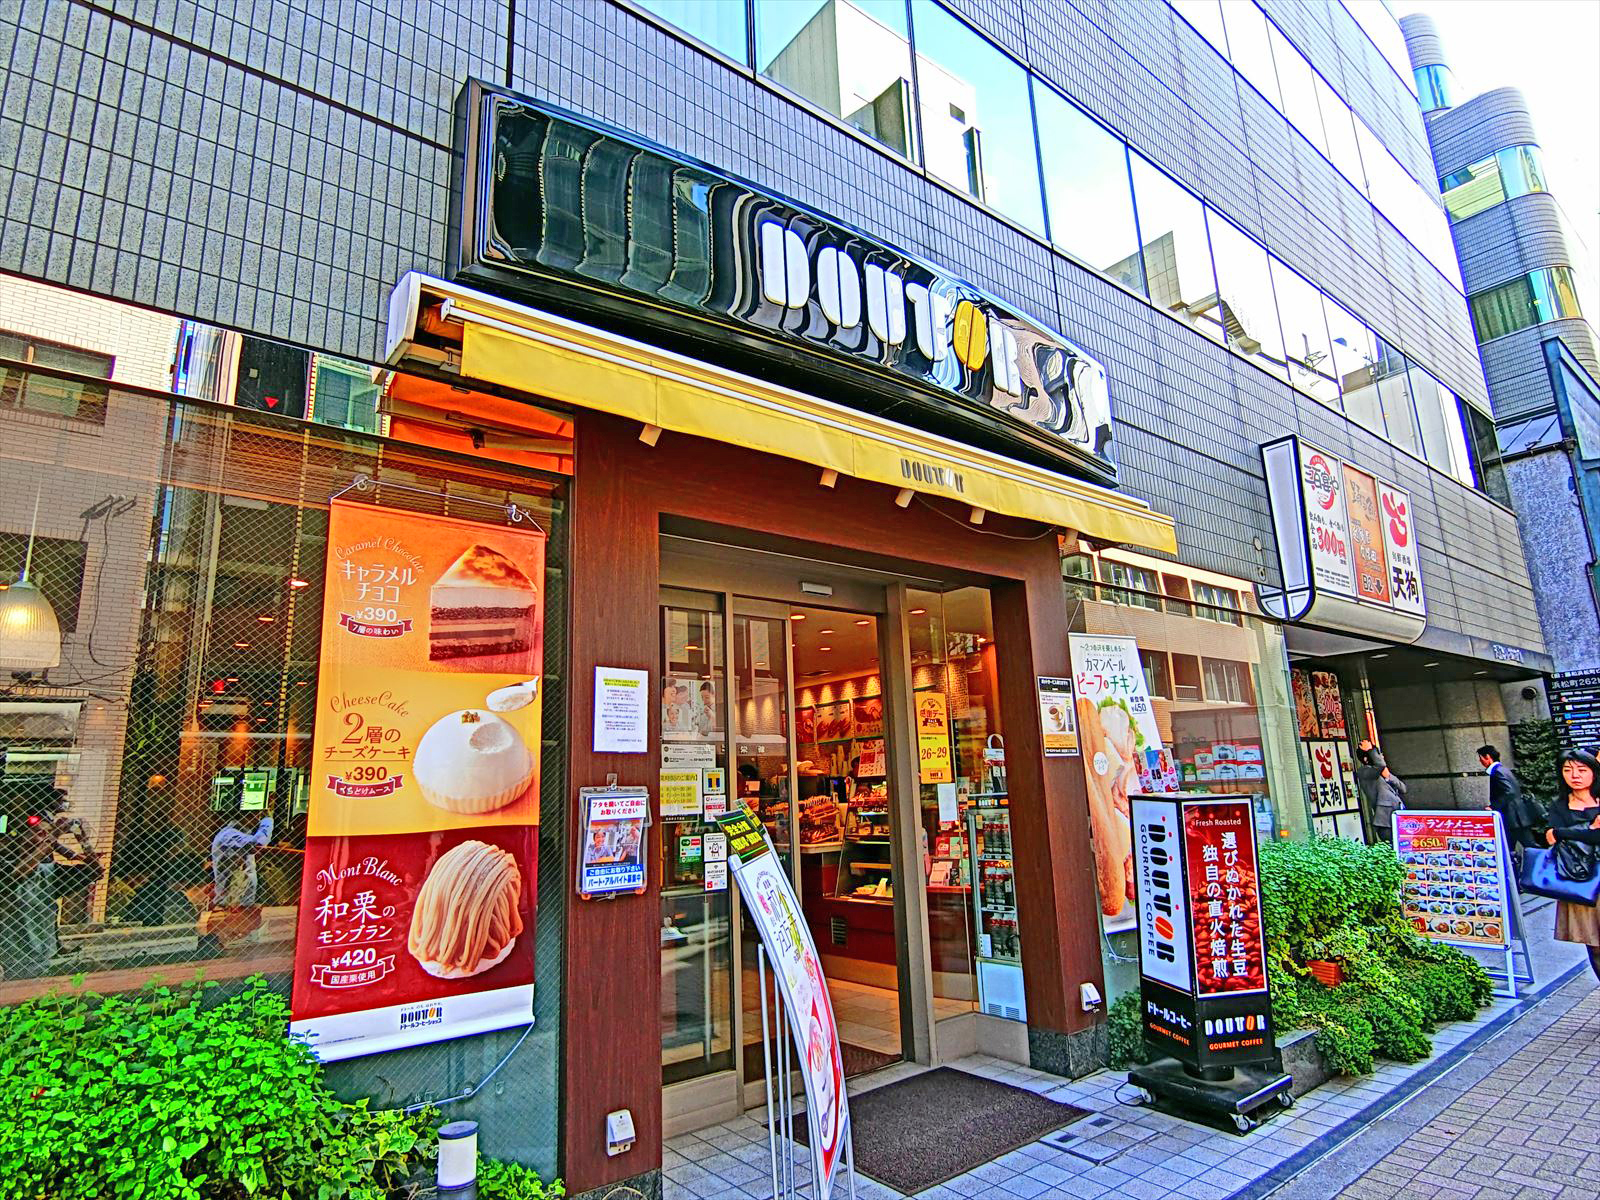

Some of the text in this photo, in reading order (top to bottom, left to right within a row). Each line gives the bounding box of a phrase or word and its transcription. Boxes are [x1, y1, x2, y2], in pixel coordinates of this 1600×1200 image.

[761, 222, 1021, 399] DOUTOR
[900, 458, 964, 493] DOUTOR
[335, 536, 424, 574] Caramel Chocolate
[1317, 526, 1346, 560] 300円
[342, 561, 416, 585] キャラメル
[1362, 573, 1374, 593] B2
[1392, 566, 1419, 604] 天狗
[357, 583, 400, 603] チョコ
[356, 607, 397, 622] ¥390
[1085, 658, 1126, 673] カマンベール
[341, 712, 401, 744] 2層の
[324, 745, 410, 760] チーズケーキ
[345, 766, 387, 781] ¥390
[1320, 782, 1342, 808] 天狗
[1426, 819, 1493, 829] ランチメニュー
[316, 857, 402, 891] Mont Blanc
[1140, 824, 1155, 957] GOURMET COFFEE
[1148, 824, 1174, 963] DOUTOR
[314, 890, 395, 926] 和栗の
[1202, 845, 1229, 978] 独自の直火焙煎
[1221, 832, 1248, 977] 選びぬかれた生豆
[317, 924, 392, 944] モンブラン
[331, 948, 376, 968] ¥420
[330, 970, 376, 985] 国産栗使用
[400, 1006, 442, 1024] DOUTOR
[1147, 1001, 1191, 1028] ドトールコーヒー
[1204, 1015, 1265, 1036] DOUTOR
[1150, 1023, 1190, 1046] GOURMET COFFEE
[1209, 1038, 1263, 1051] GOURMET COFFEE
